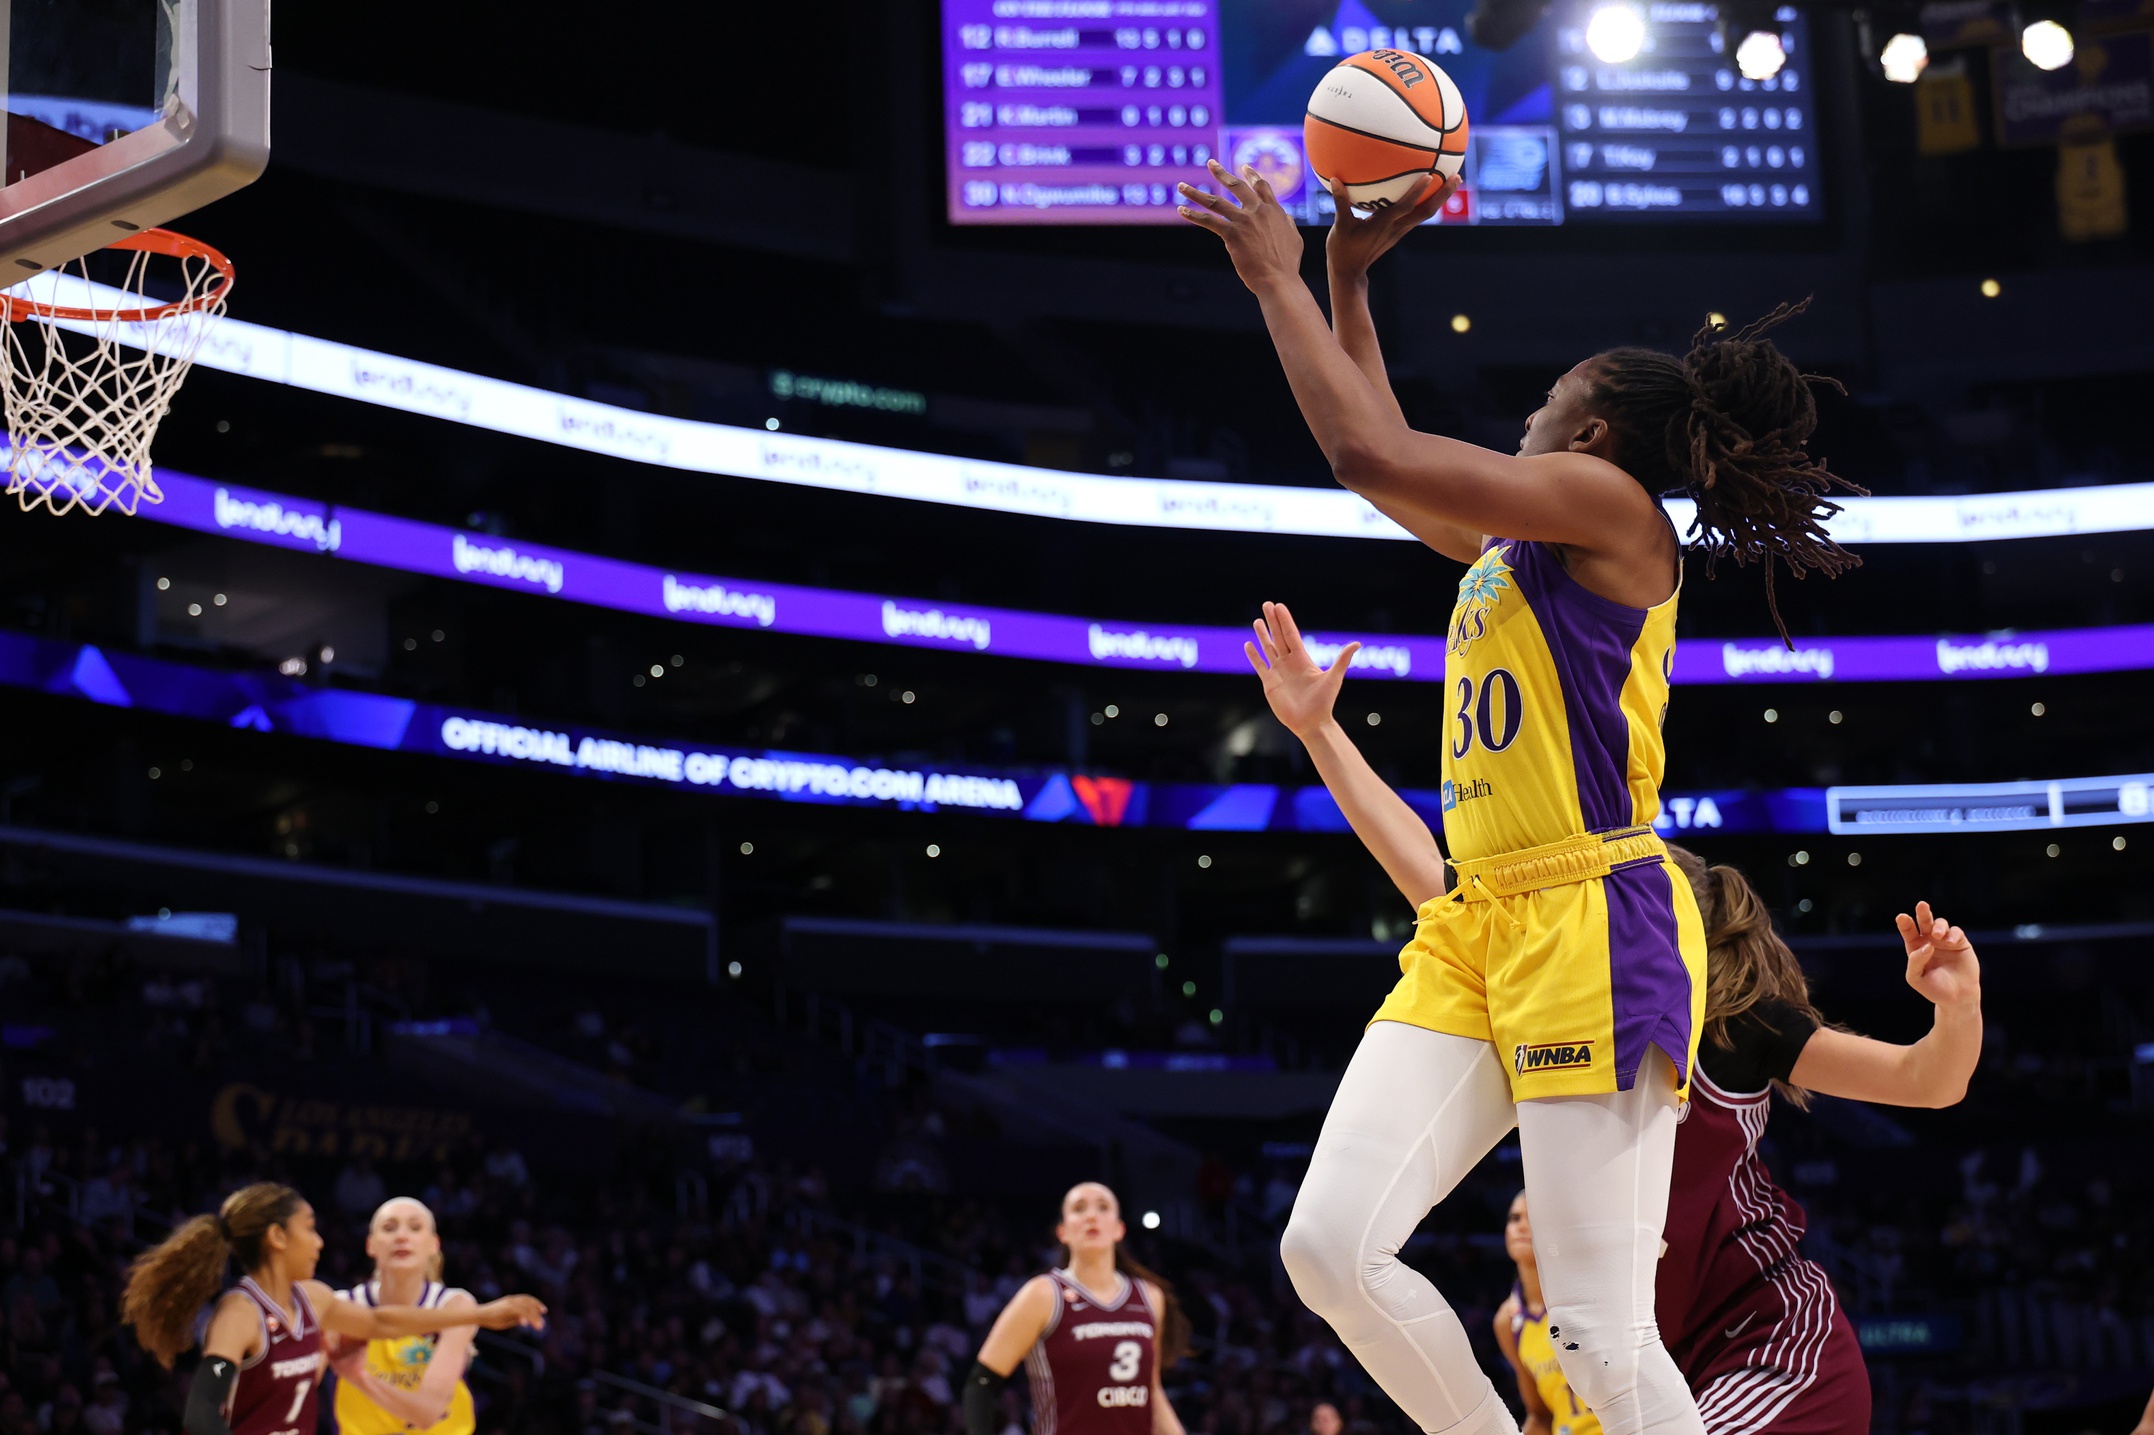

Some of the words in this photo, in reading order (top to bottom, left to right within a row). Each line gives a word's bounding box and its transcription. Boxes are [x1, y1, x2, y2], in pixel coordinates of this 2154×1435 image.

[1343, 26, 1463, 54] DELTA
[1452, 667, 1524, 760] 30
[441, 717, 575, 766] OFFICIAL
[577, 737, 684, 782] AIRLINE
[685, 752, 729, 786] OF
[730, 757, 924, 802] CRYPTO.COM
[925, 773, 1023, 810] ARENA
[1453, 778, 1493, 802] Health
[1653, 797, 1723, 829] LTA
[1527, 1045, 1591, 1067] WNBA
[1110, 1340, 1142, 1382] 3
[285, 1378, 312, 1423] 1
